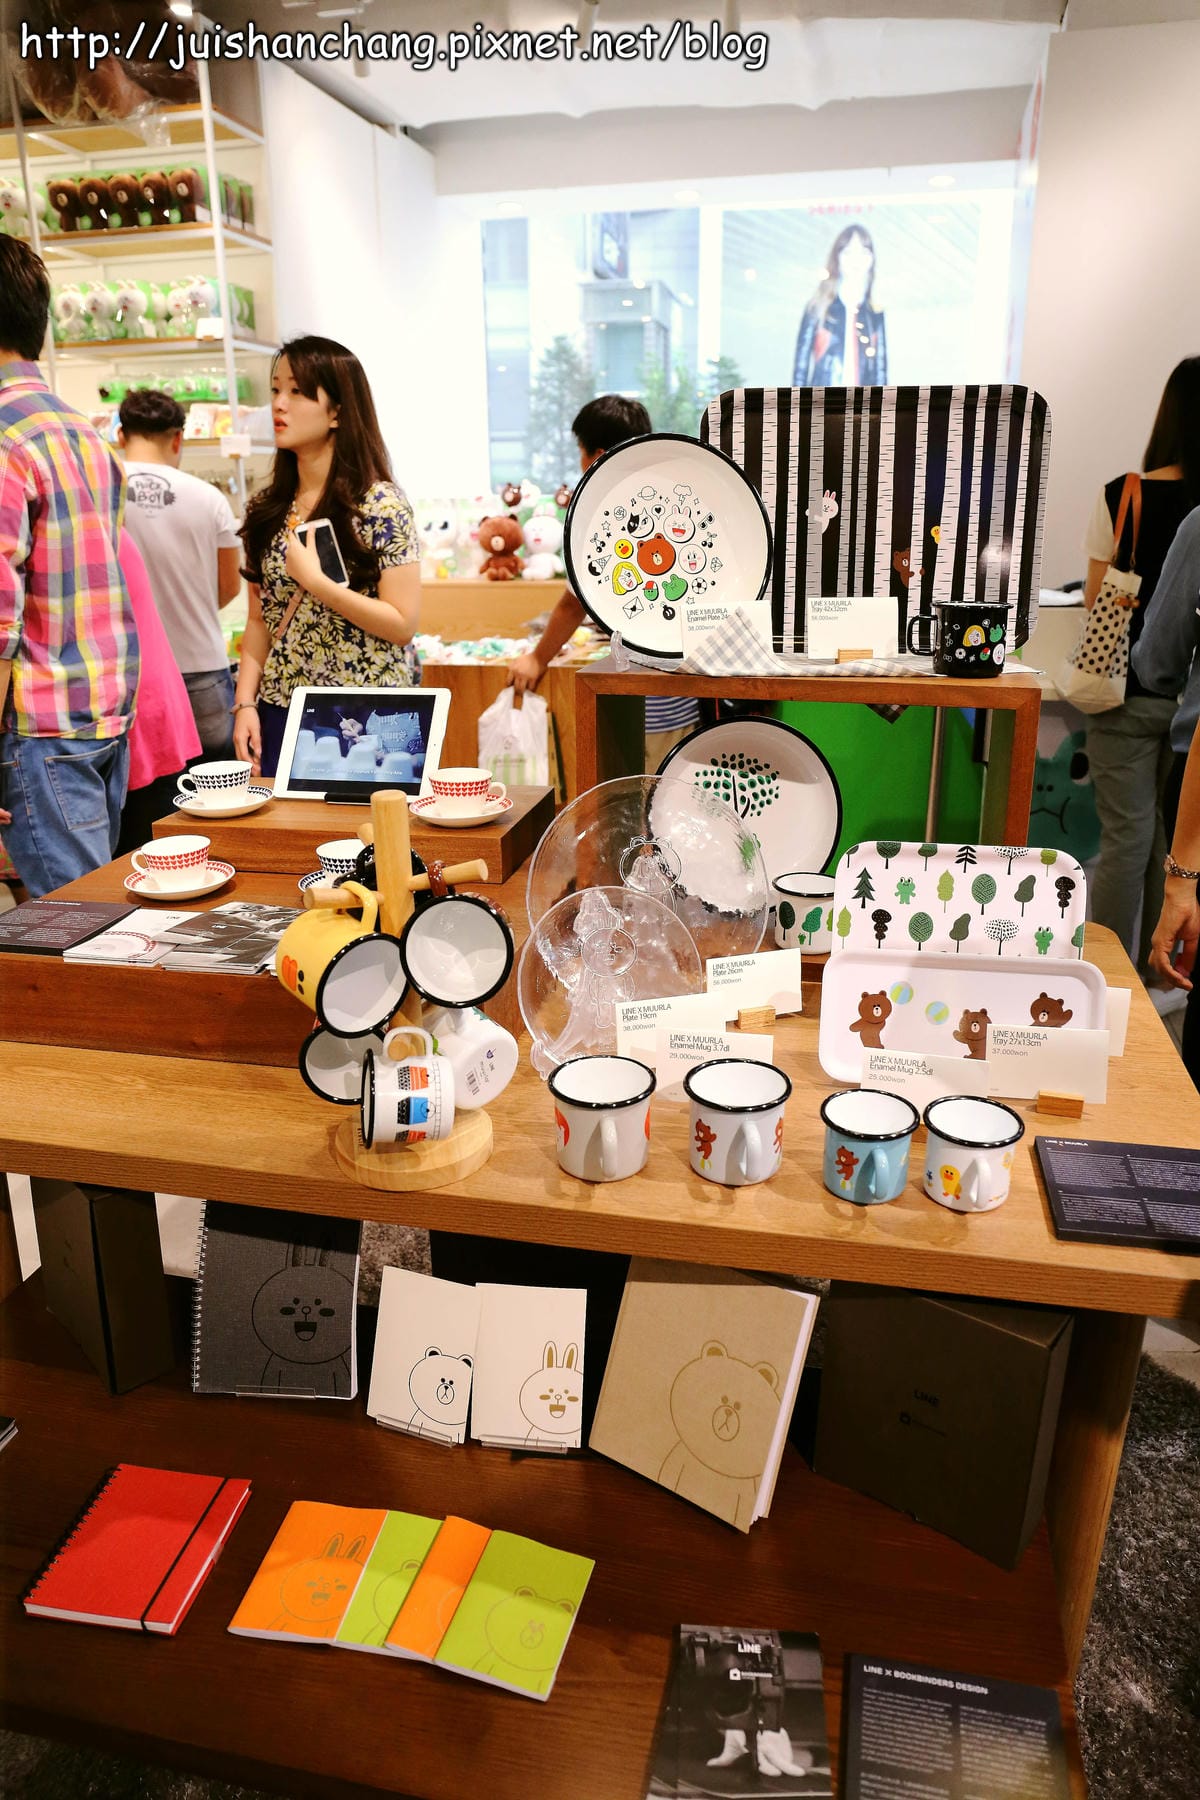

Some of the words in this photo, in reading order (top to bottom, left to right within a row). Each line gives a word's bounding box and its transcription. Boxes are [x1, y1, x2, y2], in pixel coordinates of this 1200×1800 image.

[712, 962, 725, 971] LINE
[730, 959, 756, 968] MUURLA
[712, 969, 727, 977] Plate
[727, 967, 744, 975] 26cm
[621, 1007, 637, 1015] LINE
[643, 1003, 672, 1013] MUURLA
[622, 1014, 639, 1022] Plate
[640, 1012, 657, 1020] 19cm
[669, 1034, 686, 1042] LINE
[692, 1036, 723, 1044] MUURLA
[992, 1030, 1009, 1038] LINE
[1016, 1031, 1048, 1040] MUURLA
[669, 1041, 695, 1050] Enamel
[696, 1043, 711, 1052] Mug
[712, 1044, 730, 1052] 3.7dl
[992, 1037, 1008, 1046] Tray
[1009, 1037, 1041, 1047] 27x13cm
[870, 1055, 887, 1063] LINE
[894, 1058, 927, 1068] MUURLA
[869, 1062, 896, 1072] Enamel
[897, 1065, 914, 1075] Mug
[737, 1643, 762, 1654] LINE
[863, 1665, 883, 1675] LINE
[893, 1670, 955, 1688] BOOKBINDERS
[955, 1681, 989, 1695] DESIGN
